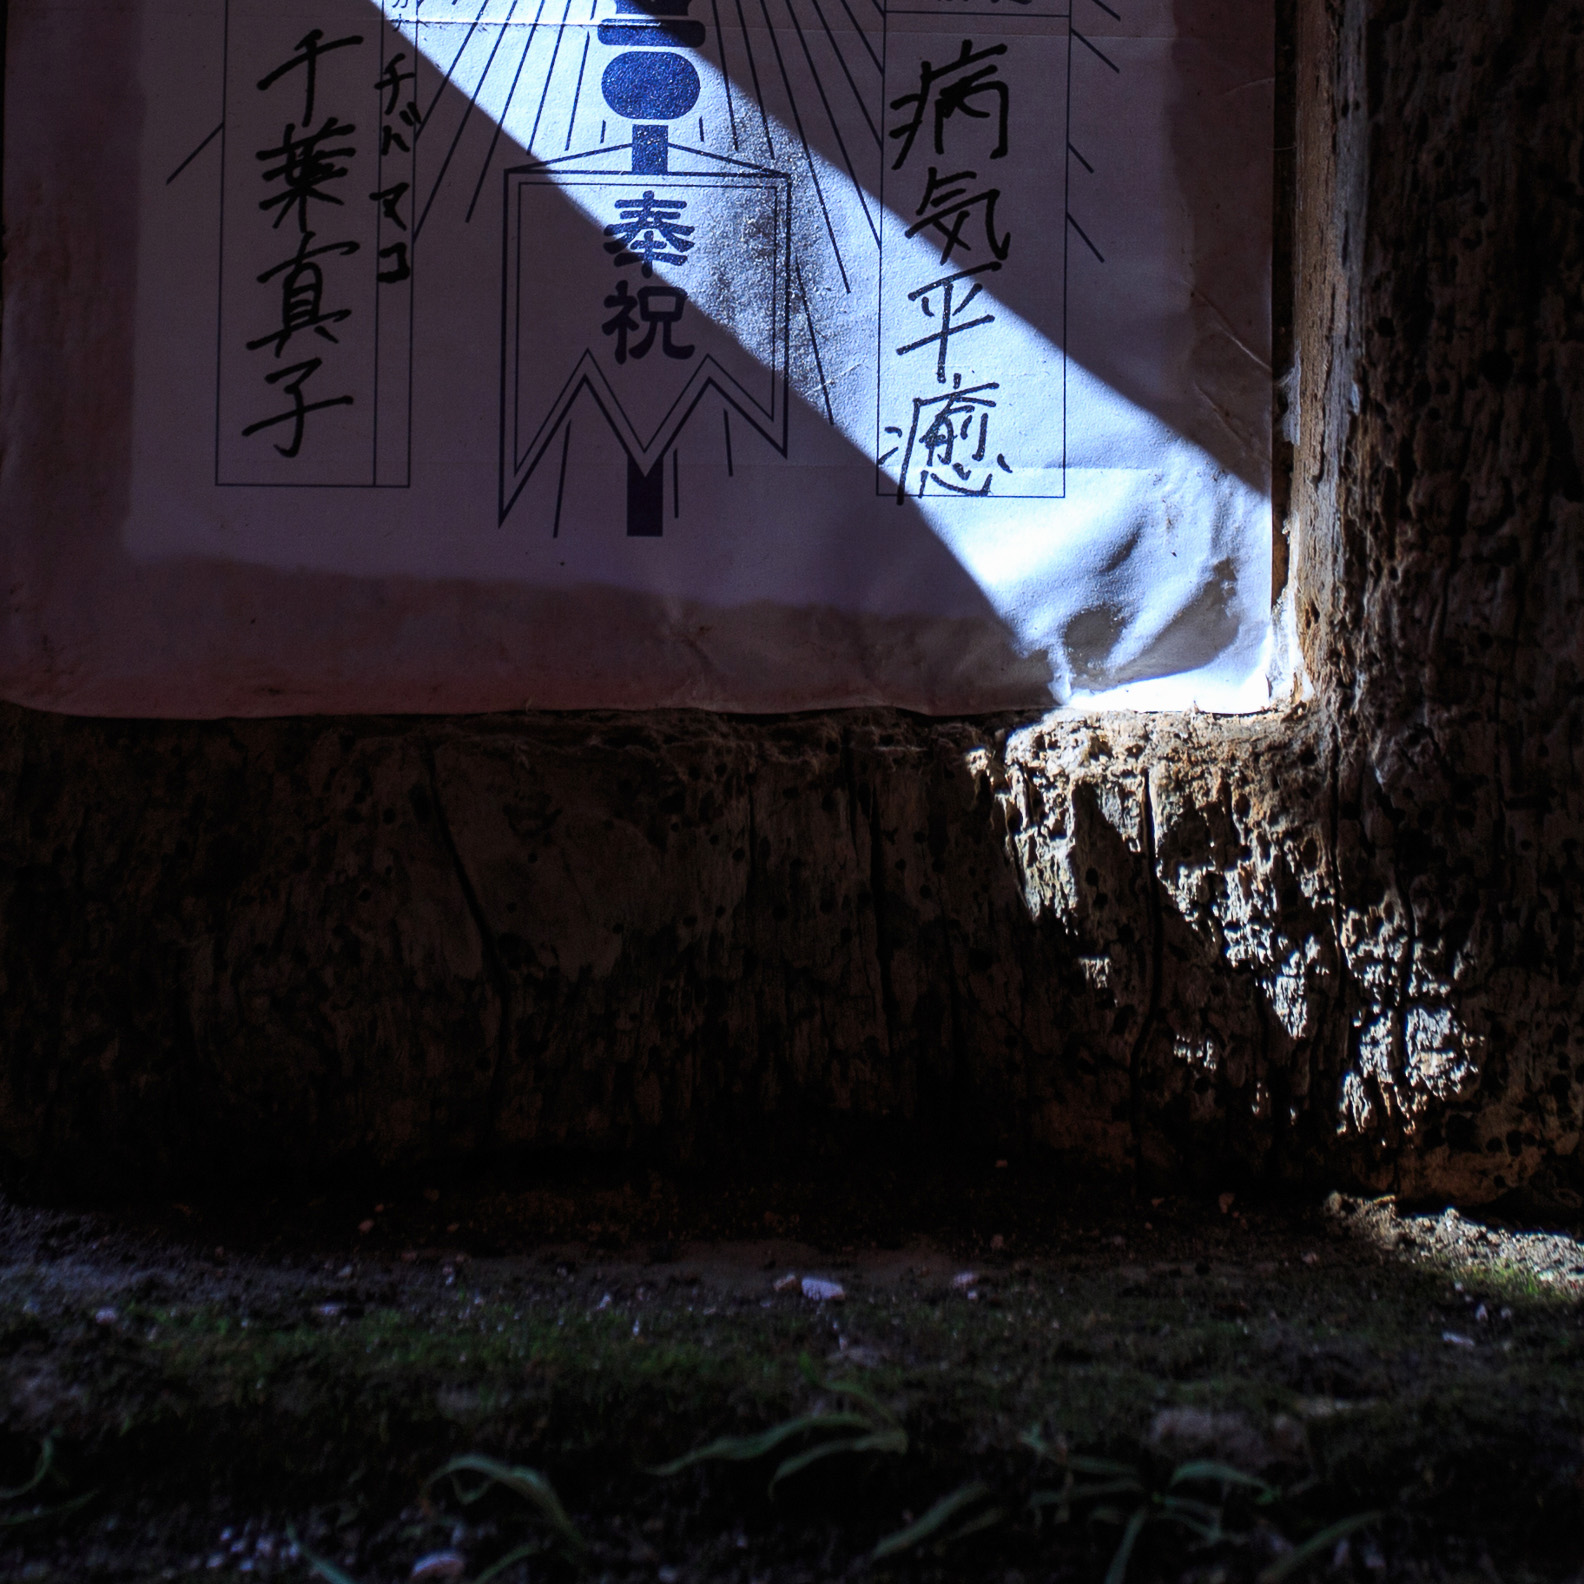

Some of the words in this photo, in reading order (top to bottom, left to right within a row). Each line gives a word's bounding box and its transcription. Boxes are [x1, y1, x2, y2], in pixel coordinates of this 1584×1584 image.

[241, 28, 365, 458] 千葉真子
[602, 190, 695, 364] 奉祝
[877, 39, 1013, 505] 病気平癒
